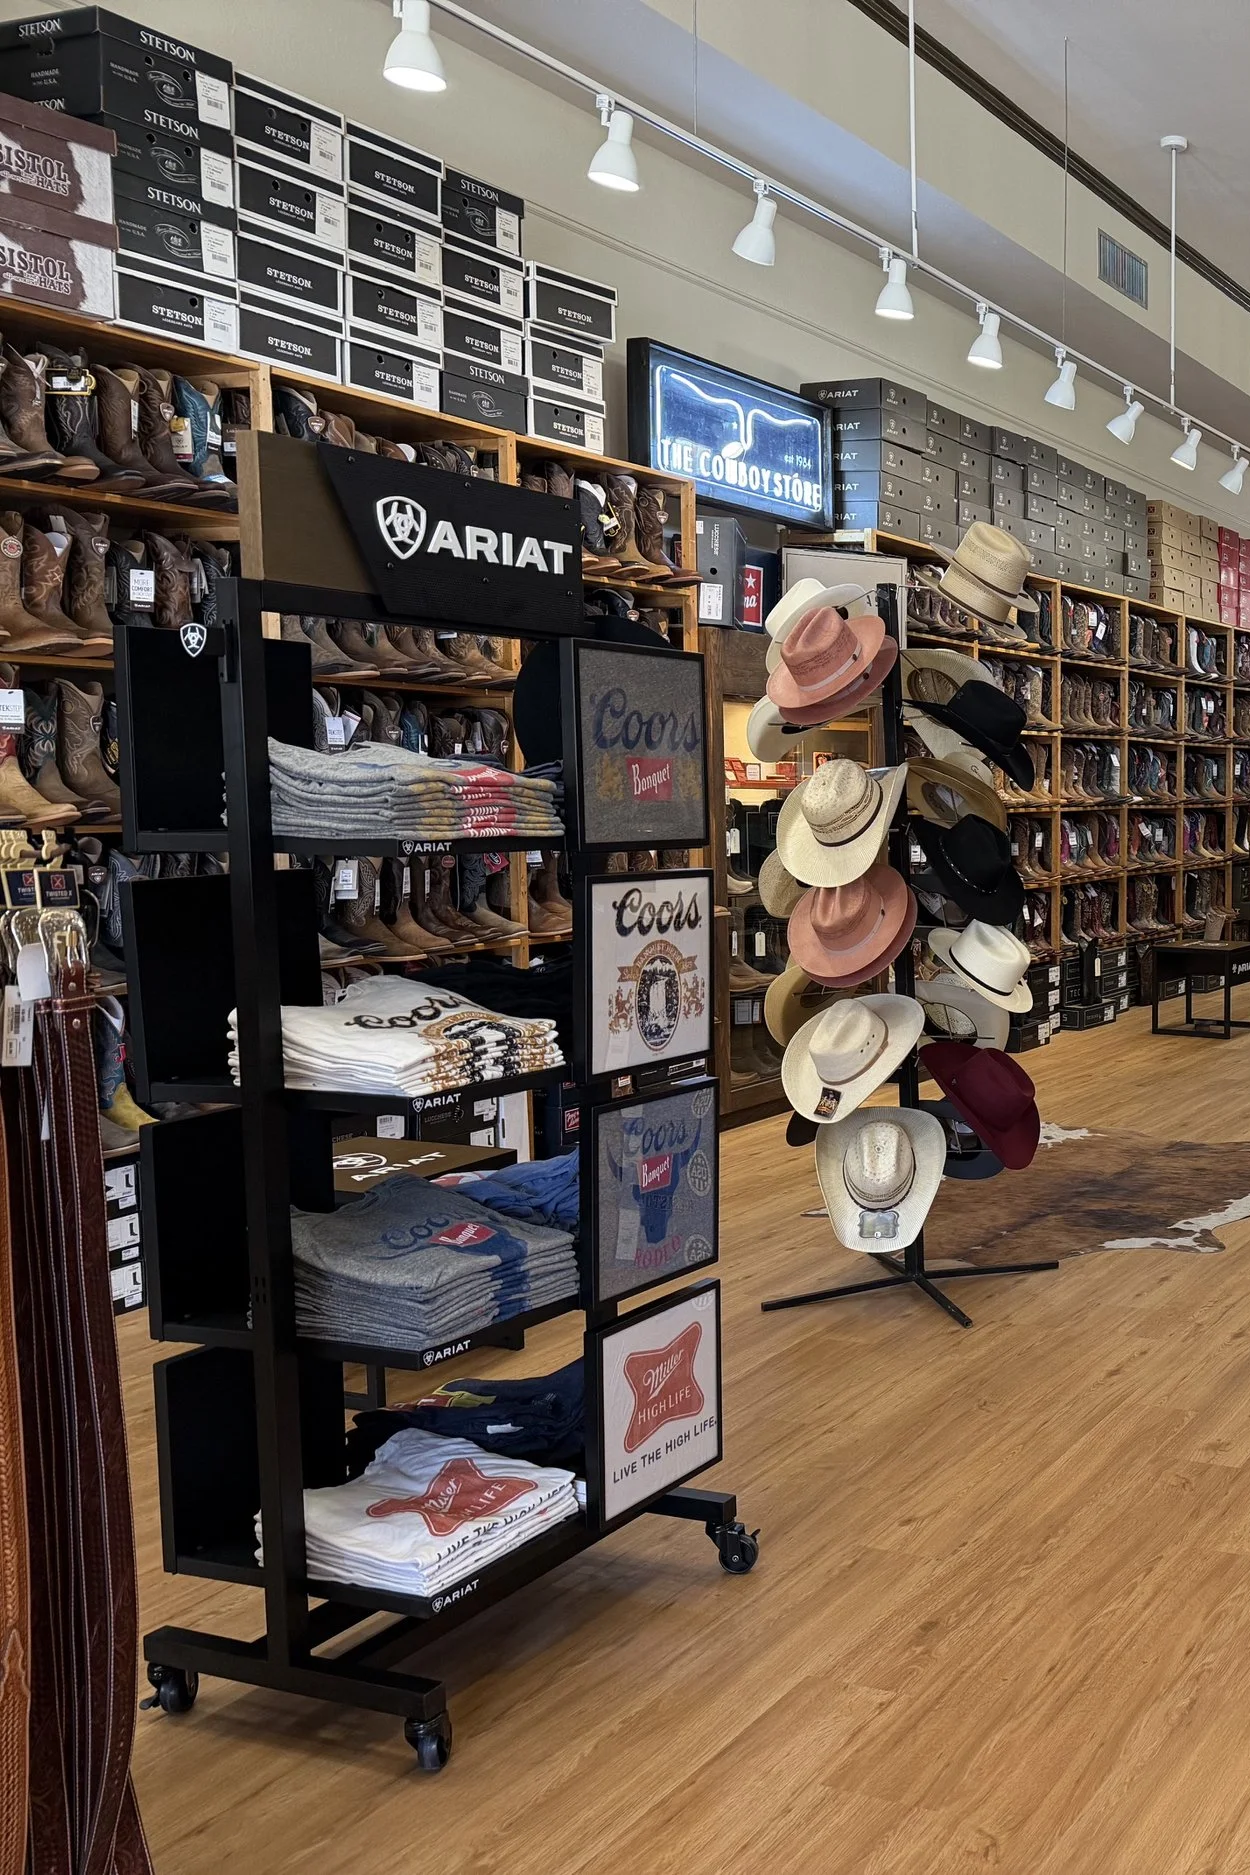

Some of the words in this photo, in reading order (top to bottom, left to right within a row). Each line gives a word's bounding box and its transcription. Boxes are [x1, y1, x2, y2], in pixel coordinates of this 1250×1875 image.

[19, 18, 62, 37] STETSON
[139, 30, 196, 63] STETSON
[144, 109, 199, 140] STETSON
[264, 125, 310, 150] STETSON
[0, 143, 70, 184] ISTOL
[36, 175, 69, 195] HATS
[374, 170, 416, 194] STETSON
[460, 178, 500, 202] STETSON
[147, 186, 201, 214] STETSON
[269, 196, 314, 220] STETSON
[373, 238, 413, 259] STETSON
[38, 275, 71, 295] HATS
[266, 267, 312, 288] STETSON
[464, 274, 500, 293] STETSON
[152, 304, 203, 326] STETSON
[377, 304, 417, 323] STETSON
[557, 306, 592, 324] STETSON
[267, 336, 312, 357] STETSON
[464, 335, 499, 353] STETSON
[374, 370, 413, 387] STETSON
[469, 365, 506, 384] STETSON
[551, 364, 583, 380] STETSON
[827, 390, 859, 398] ARIAT
[553, 421, 584, 436] STETSON
[832, 422, 860, 431] RIAT
[661, 438, 693, 472] THE
[700, 449, 772, 494] COWBOY
[774, 473, 822, 510] STORE
[427, 520, 573, 575] ARIAT
[590, 688, 701, 752] Coors
[632, 763, 670, 795] Banquet
[414, 841, 452, 853] ARIAT
[18, 887, 36, 895] TWIST
[612, 888, 699, 936] Coors
[424, 1093, 461, 1109] ARIAT
[351, 1151, 446, 1182] ARIAT
[641, 1156, 670, 1188] Banquet
[440, 1222, 480, 1246] Banquet
[434, 1340, 471, 1362] ARIAT
[643, 1350, 684, 1396] Miller
[638, 1400, 667, 1425] HIGH
[668, 1385, 692, 1406] LIFE
[613, 1461, 637, 1483] LIVE
[641, 1448, 662, 1468] THE
[666, 1434, 690, 1454] HIGH
[442, 1579, 479, 1607] ARIAT
